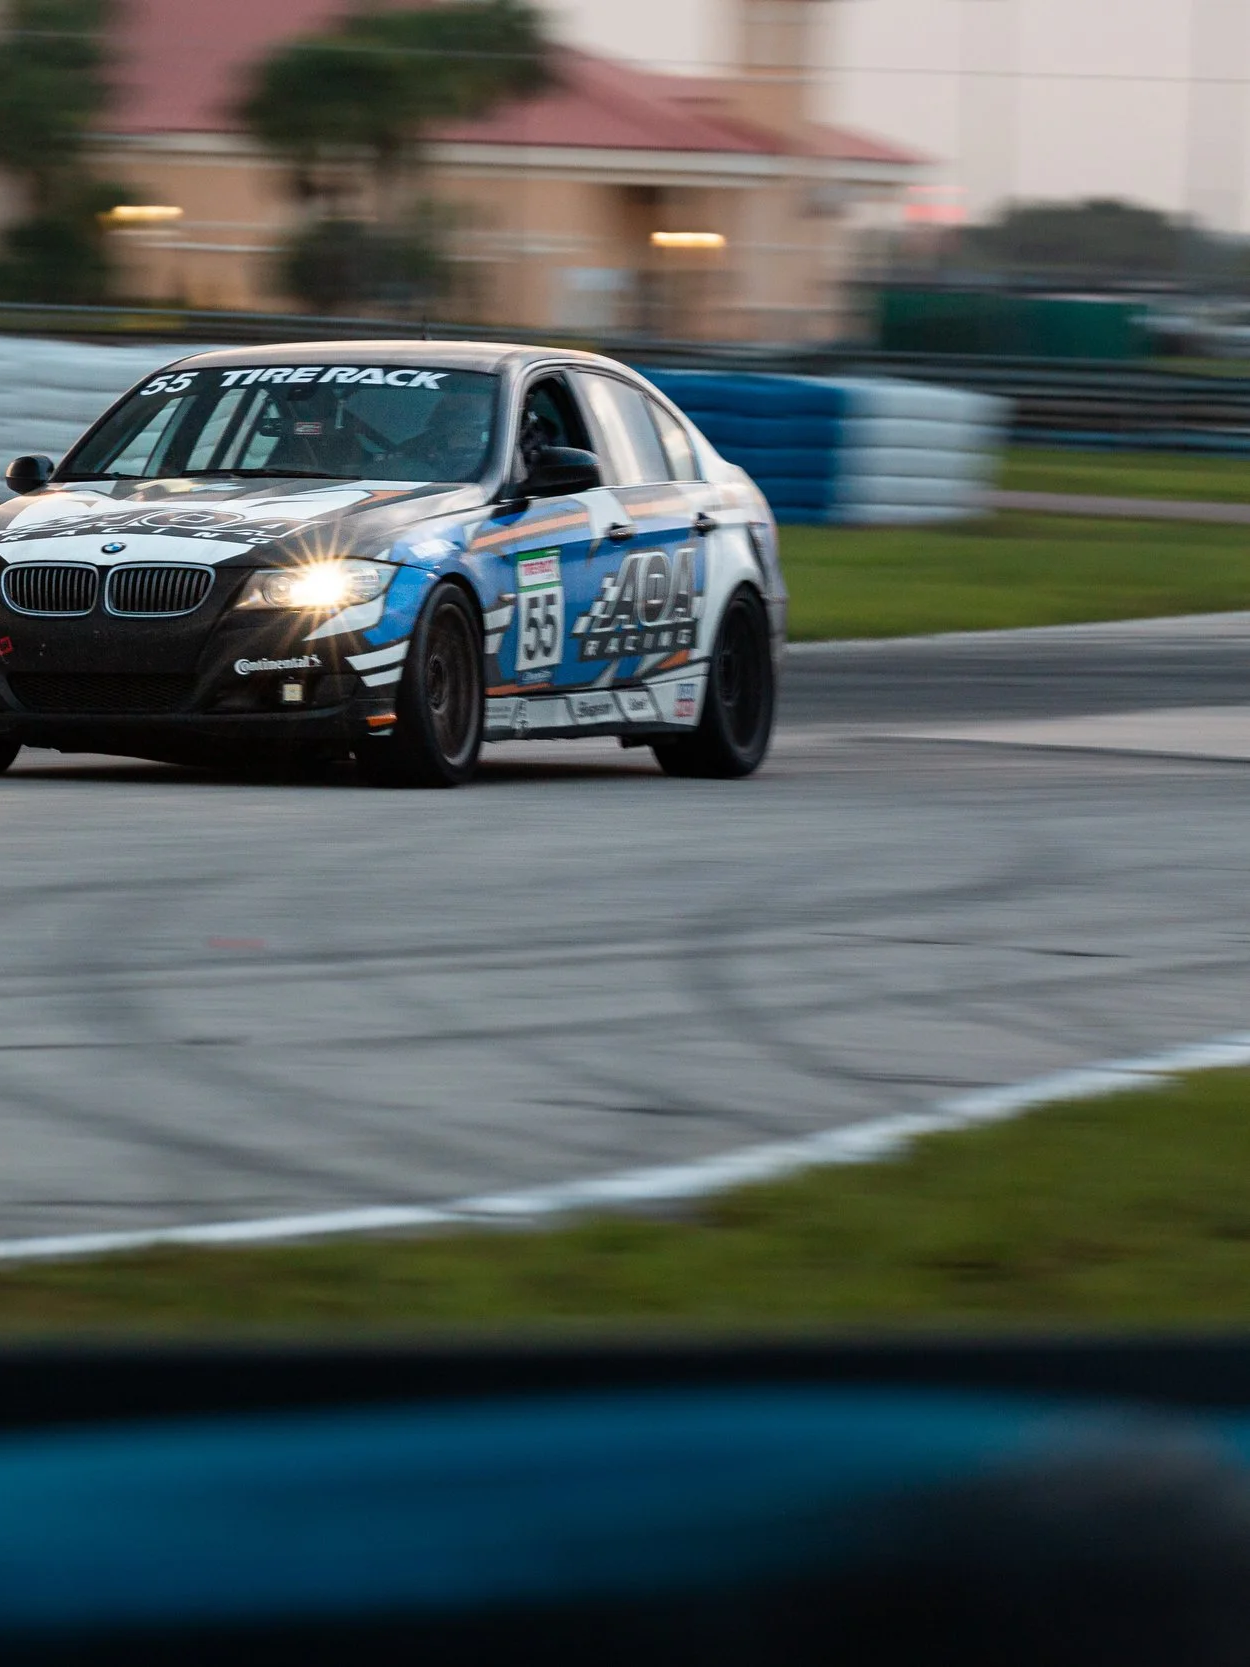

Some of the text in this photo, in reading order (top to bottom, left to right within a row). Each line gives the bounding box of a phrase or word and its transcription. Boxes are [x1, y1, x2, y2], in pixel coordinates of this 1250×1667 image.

[140, 372, 199, 396] 55
[0, 526, 274, 544] RACING
[524, 593, 558, 661] 55
[583, 629, 691, 657] RACING
[234, 655, 310, 675] Continental
